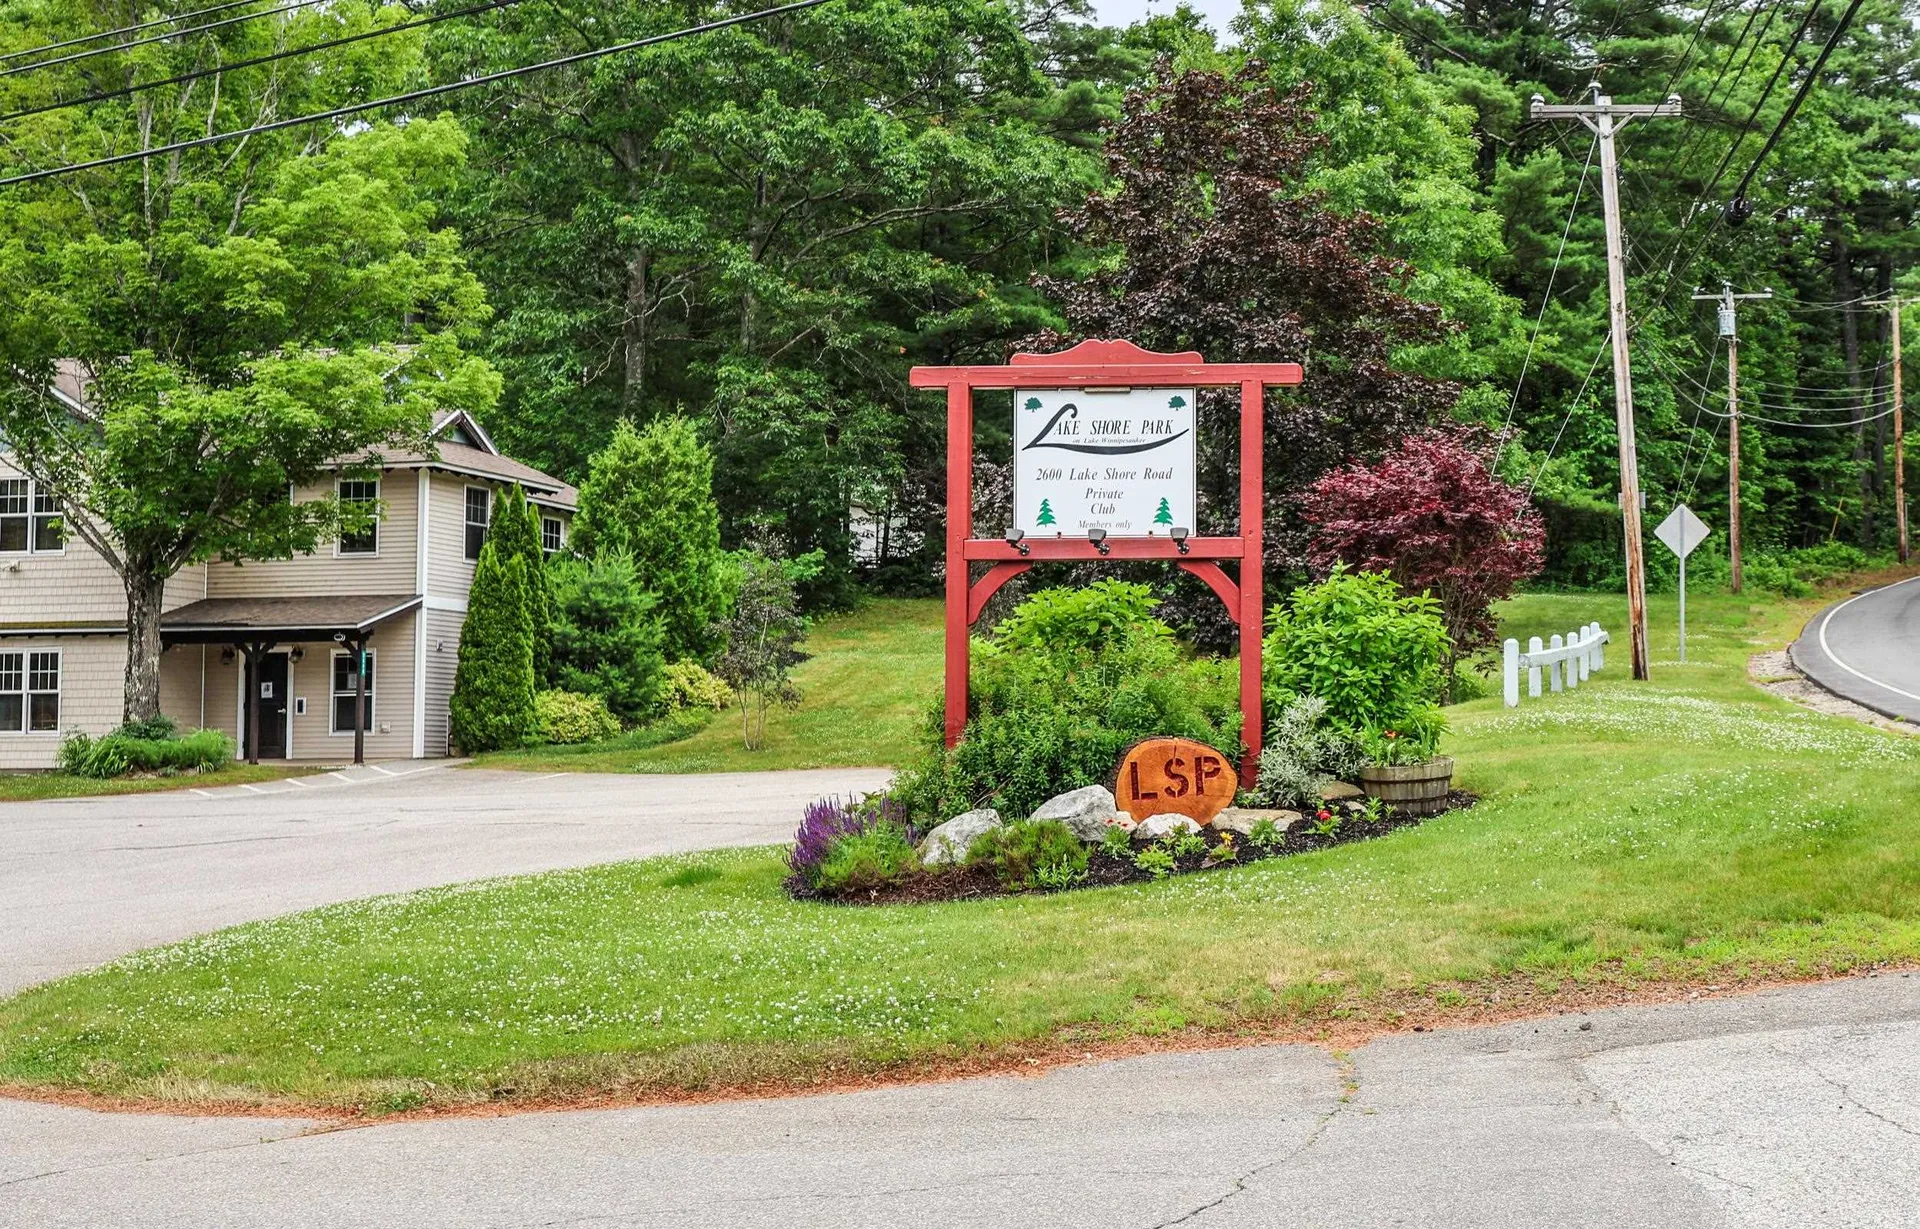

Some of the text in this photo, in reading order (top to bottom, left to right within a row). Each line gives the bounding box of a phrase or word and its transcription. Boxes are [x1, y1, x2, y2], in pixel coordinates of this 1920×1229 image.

[1090, 420, 1131, 435] SHORE
[1141, 419, 1173, 435] PARK
[1036, 467, 1173, 480] 2600 Lake Shore Road
[1085, 488, 1124, 499] Private
[1090, 503, 1116, 514] Club
[1078, 520, 1132, 530] Members only
[1130, 756, 1221, 800] LSP
